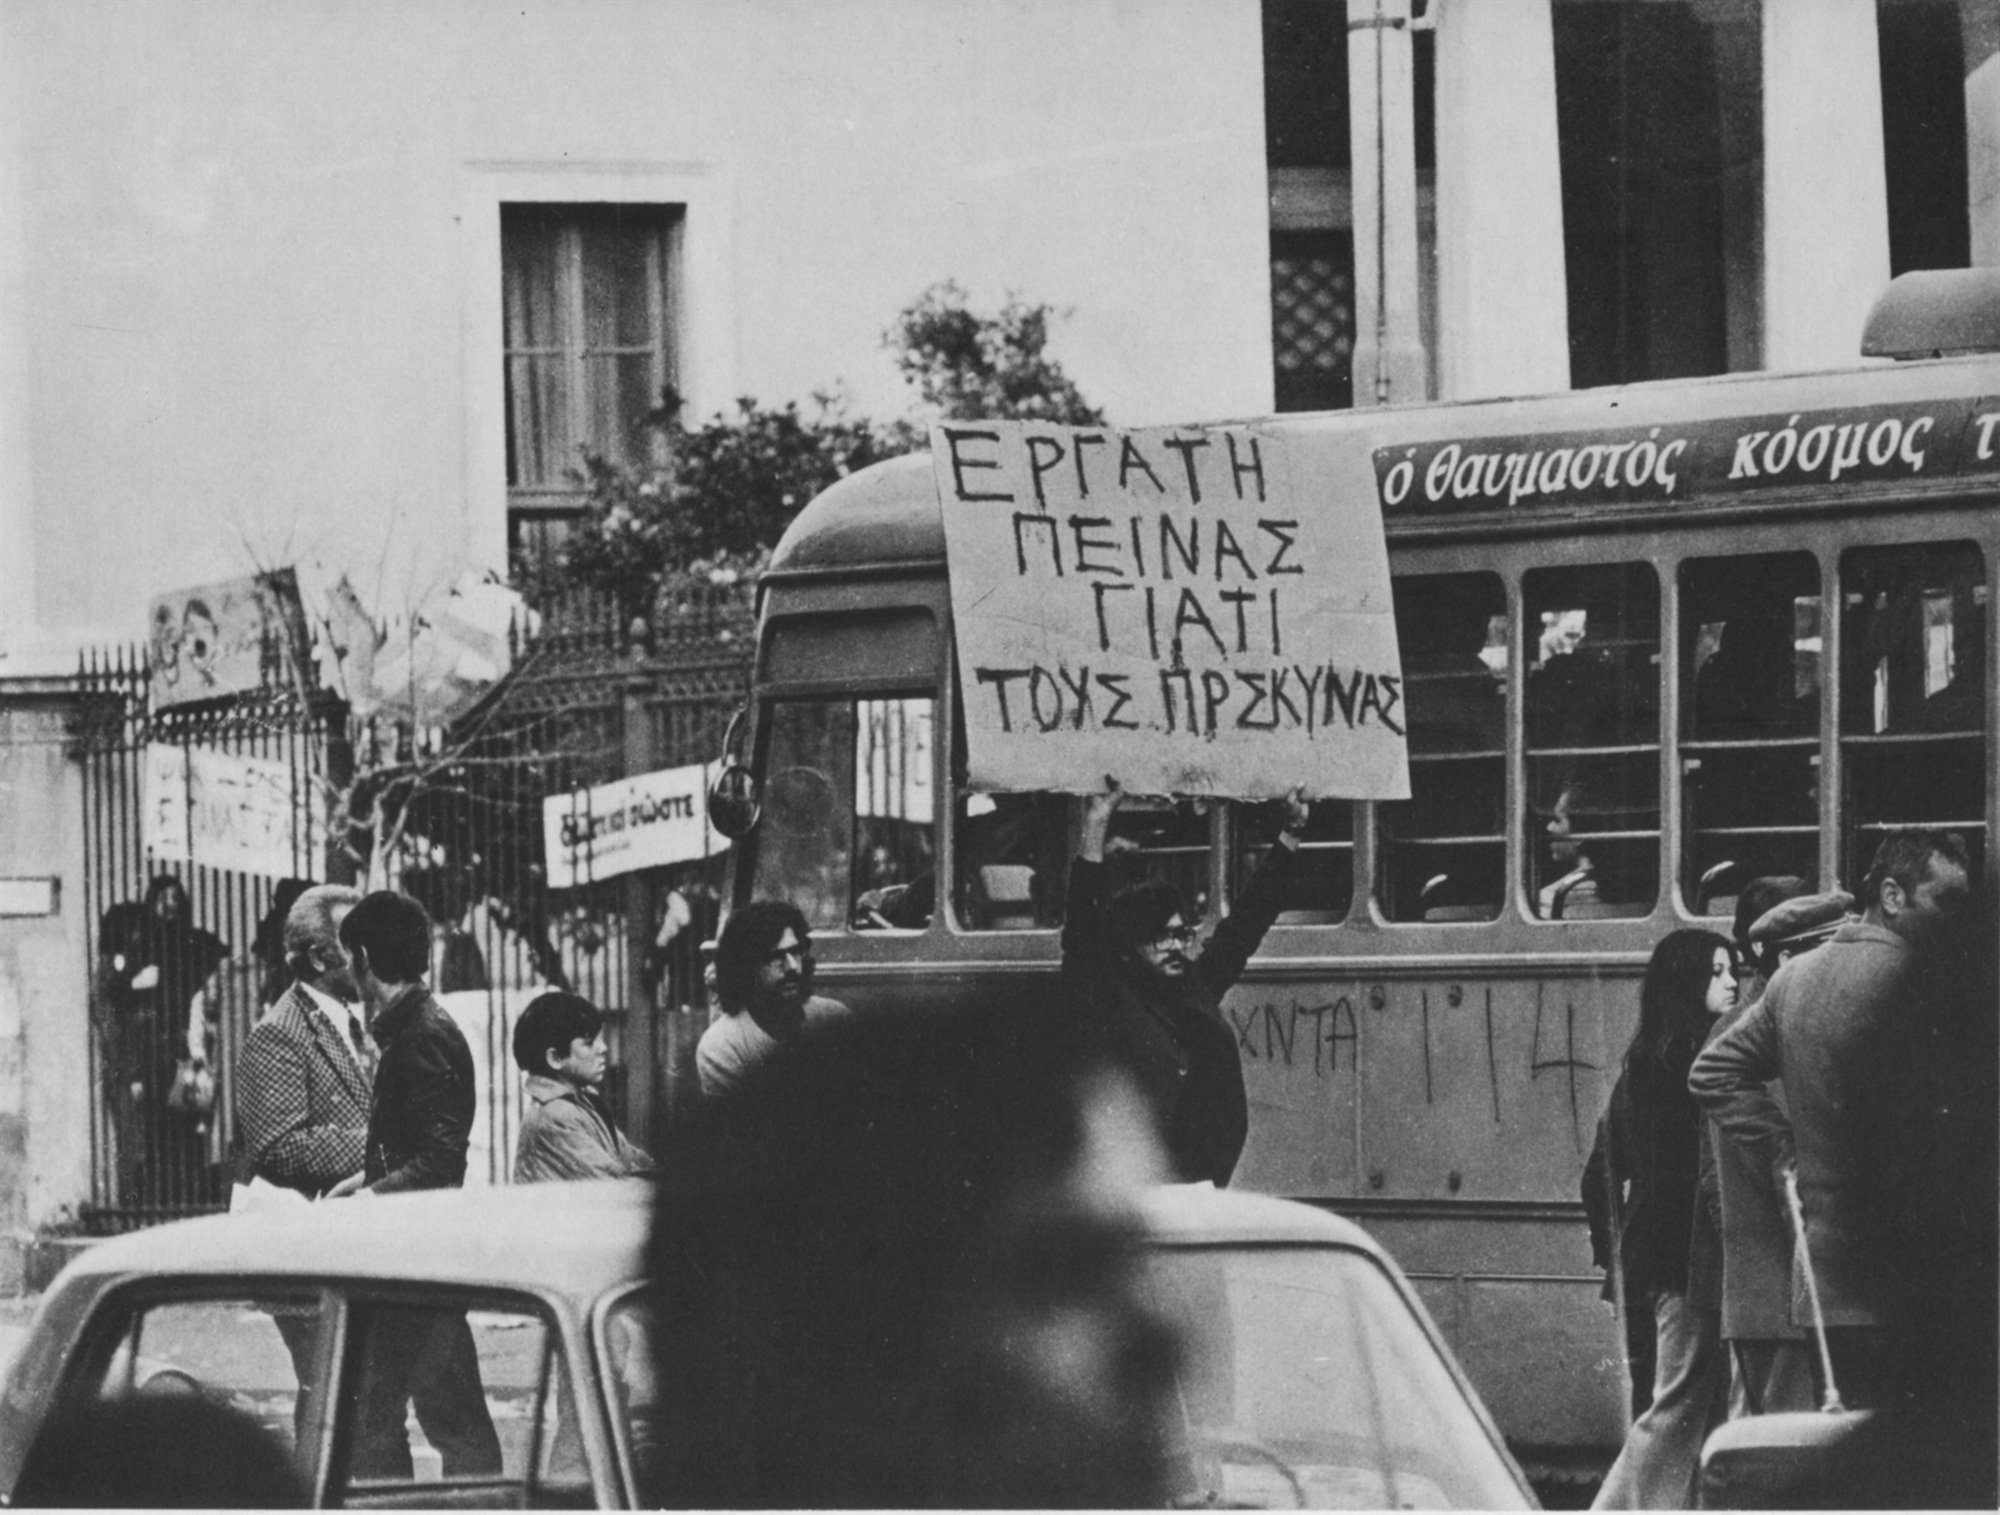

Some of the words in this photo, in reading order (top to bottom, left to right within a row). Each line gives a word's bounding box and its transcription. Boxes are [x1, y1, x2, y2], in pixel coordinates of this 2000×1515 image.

[944, 427, 1266, 507] ΕΡΓΑΤΗ
[1727, 414, 1935, 481] κόσμος
[1012, 511, 1304, 581] ΠΕΙΝΑΣ
[1091, 581, 1281, 661] ΓΙΑΤΙ
[976, 665, 1139, 733] ΤΟΥΣ
